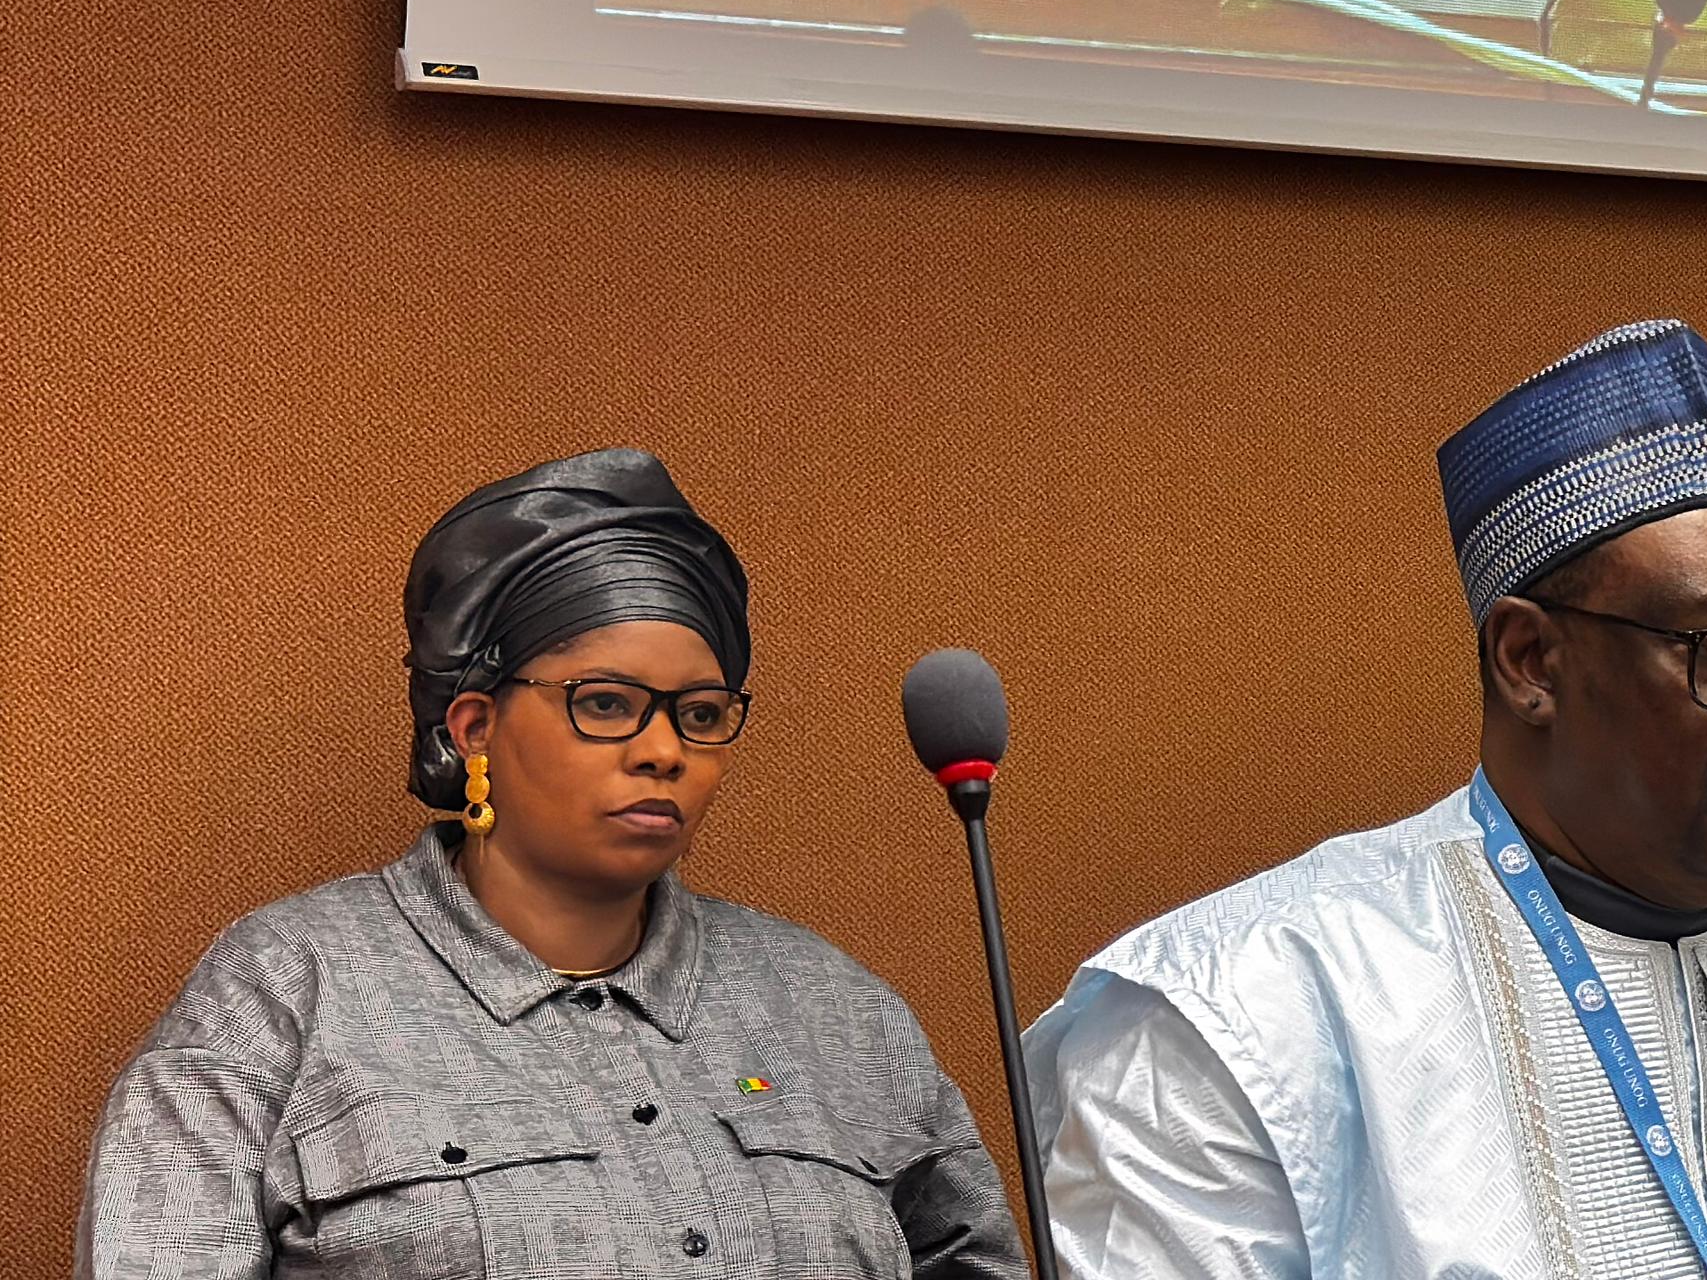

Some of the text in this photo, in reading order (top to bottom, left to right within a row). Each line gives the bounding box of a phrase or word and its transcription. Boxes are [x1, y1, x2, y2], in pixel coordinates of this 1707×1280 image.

[1528, 890, 1577, 965] ONUG UNOG
[1603, 1028, 1648, 1108] ONUG UNOG
